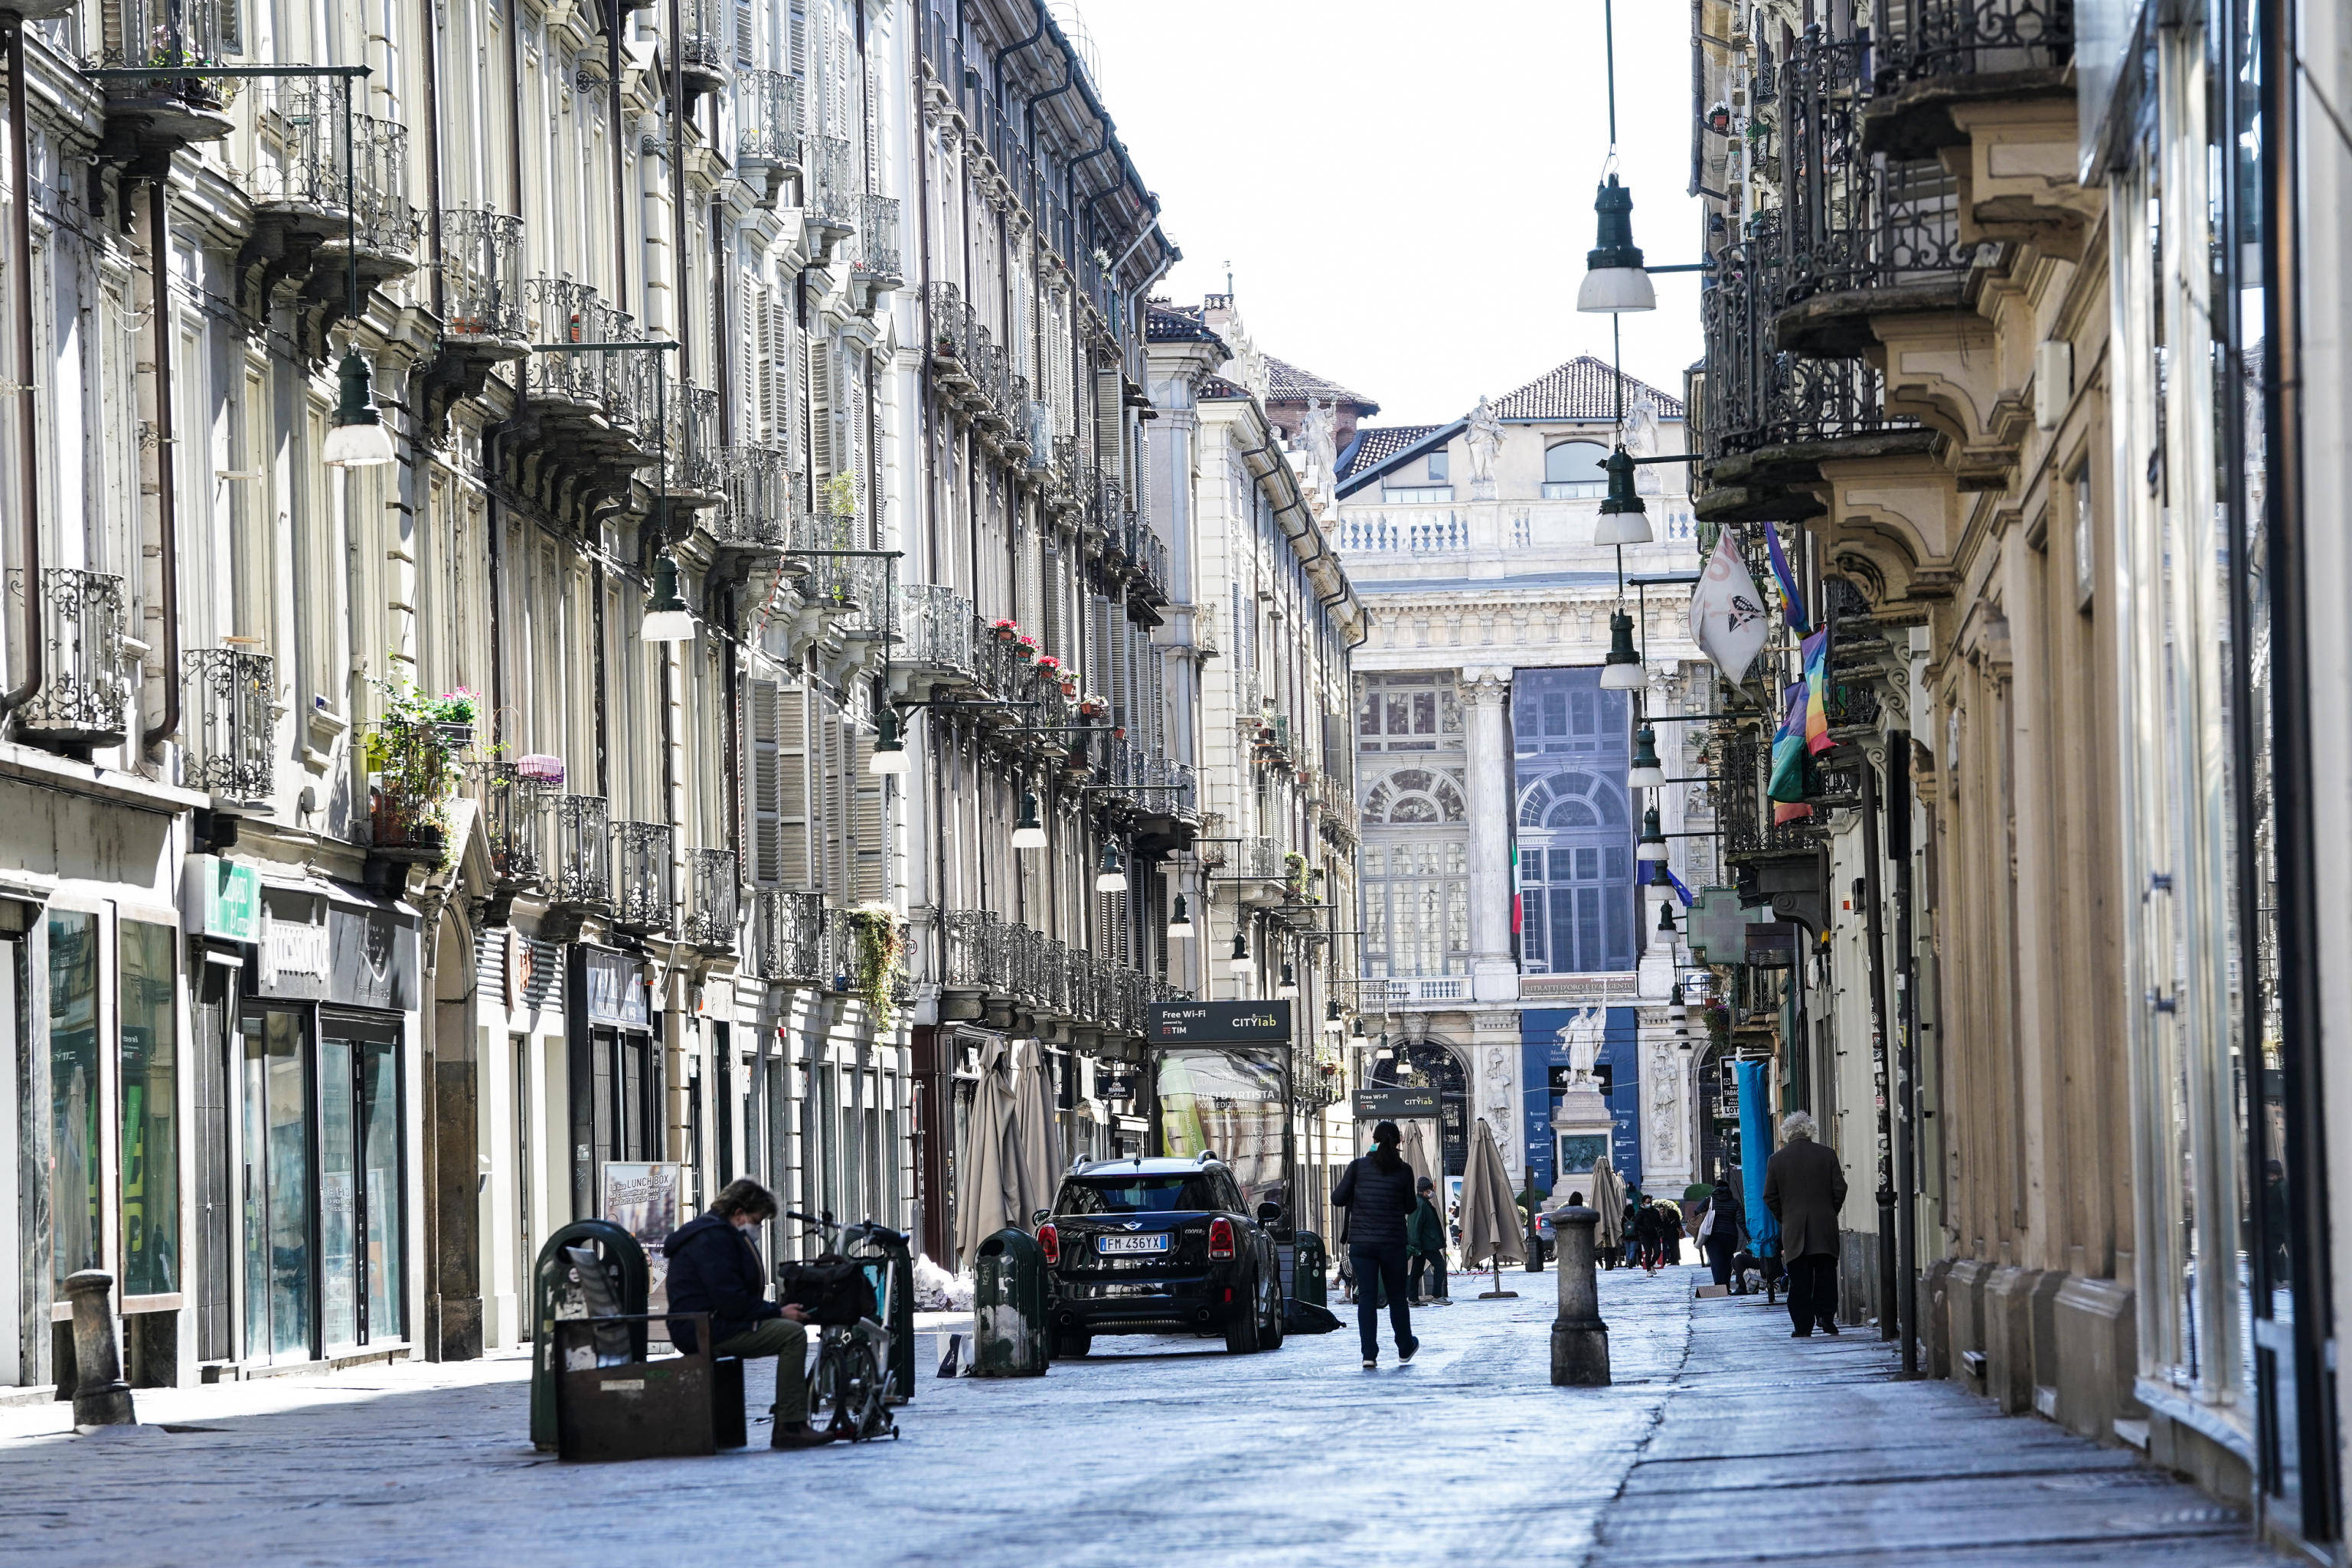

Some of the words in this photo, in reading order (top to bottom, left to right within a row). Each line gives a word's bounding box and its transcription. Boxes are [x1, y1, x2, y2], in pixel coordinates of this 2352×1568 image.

[1182, 1010, 1207, 1018] Wi-Fi
[1232, 1014, 1277, 1027] CITYlab
[1196, 1092, 1218, 1100] LUCI
[1221, 1089, 1275, 1100] D'ARTISTA
[1404, 1096, 1433, 1106] CITYlab
[627, 1177, 652, 1189] LUNCH
[654, 1174, 669, 1185] BOX
[617, 1188, 647, 1198] consumare
[661, 1183, 673, 1192] vuoi
[614, 1198, 619, 1207] in
[620, 1197, 633, 1206] tutta
[634, 1194, 661, 1204] sicurezza!
[1108, 1239, 1122, 1250] FM
[1125, 1236, 1160, 1249] 436YX
